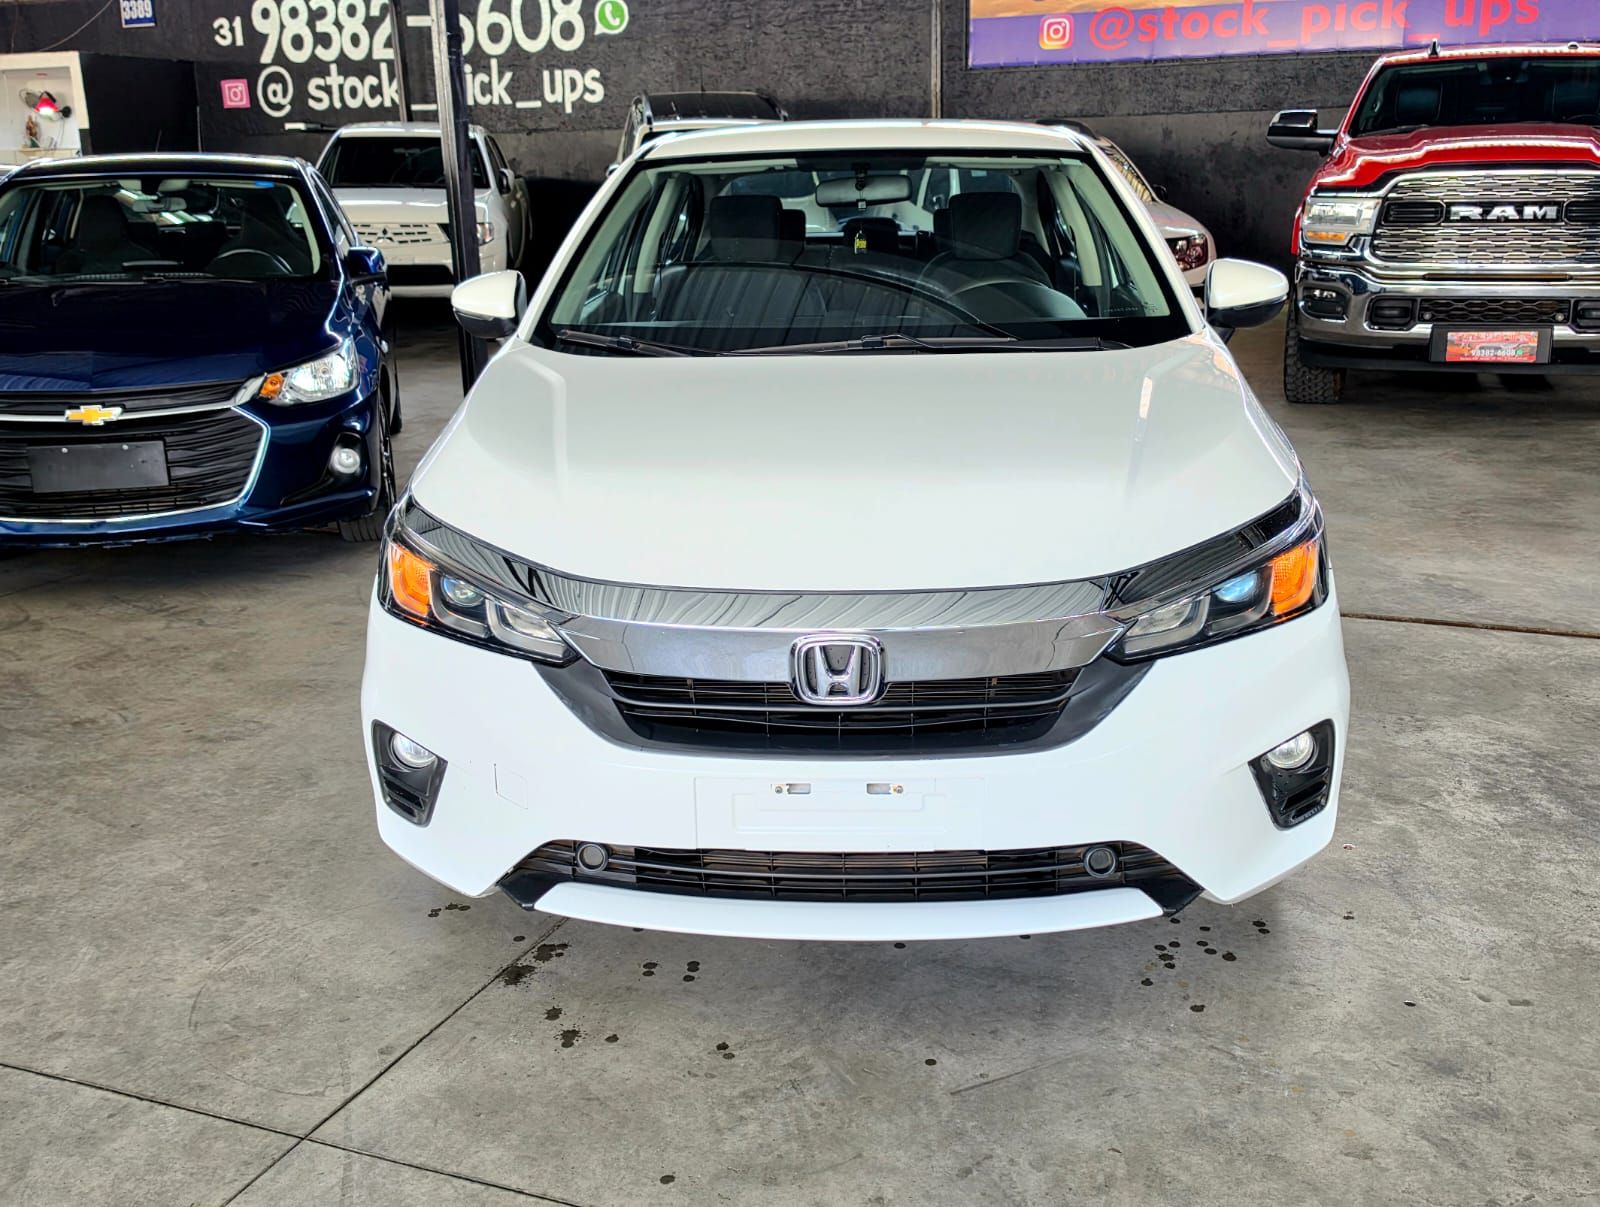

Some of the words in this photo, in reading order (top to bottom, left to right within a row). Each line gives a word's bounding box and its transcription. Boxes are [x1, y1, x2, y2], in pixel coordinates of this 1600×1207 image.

[123, 0, 153, 19] 3389
[212, 15, 244, 47] 31
[1450, 205, 1558, 220] RAM
